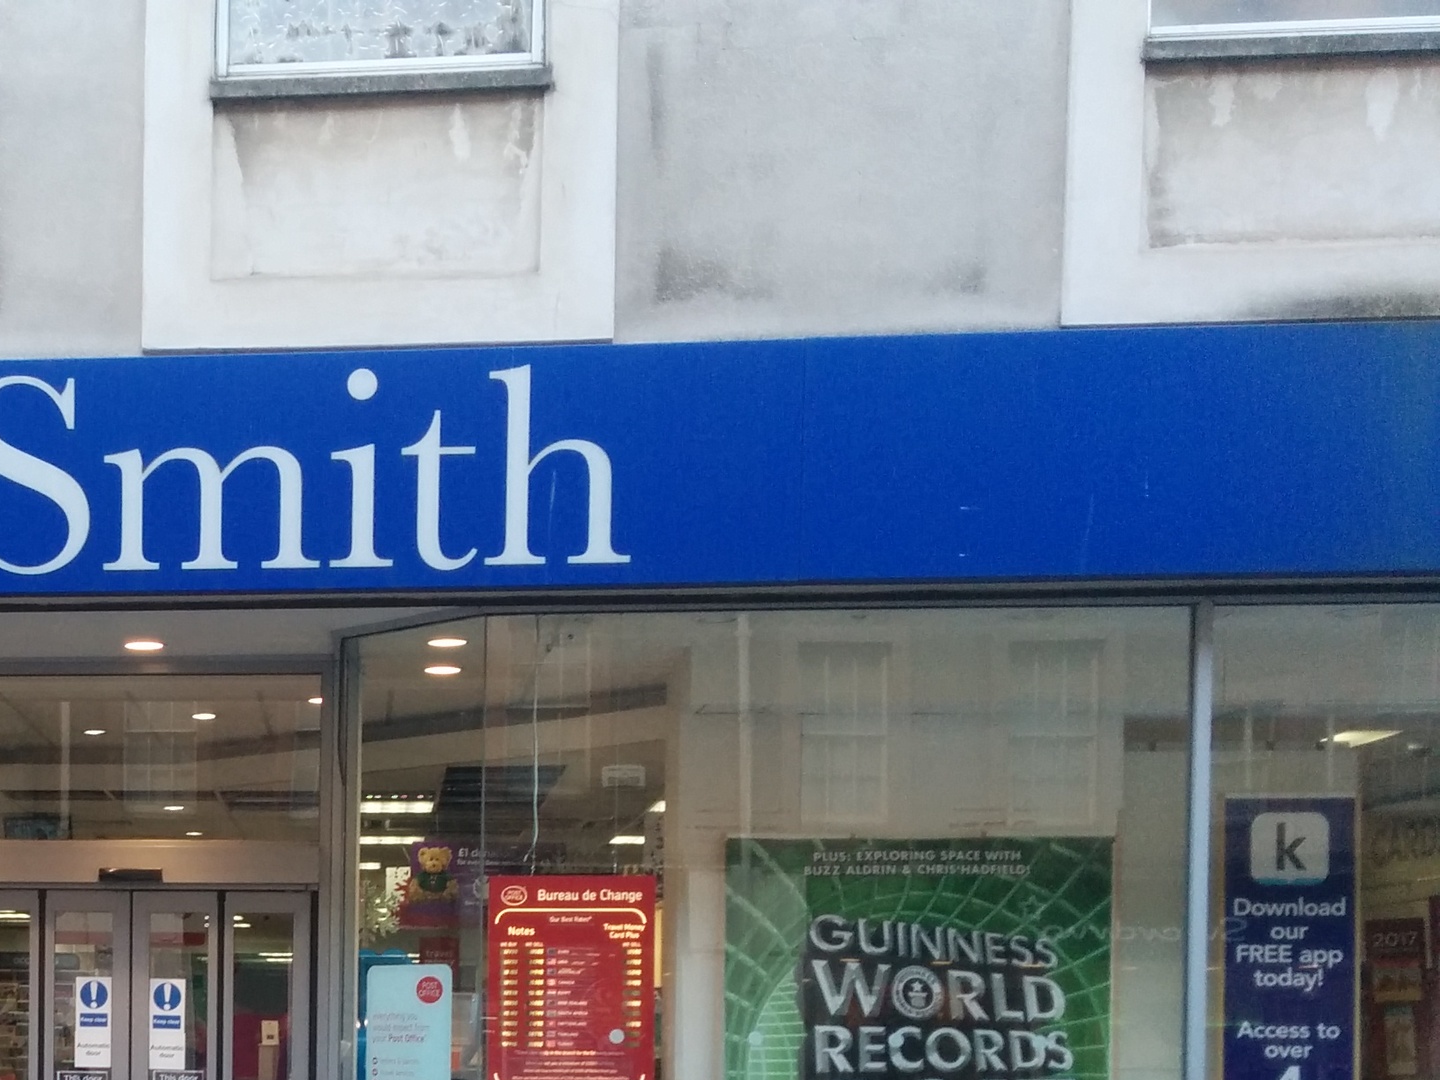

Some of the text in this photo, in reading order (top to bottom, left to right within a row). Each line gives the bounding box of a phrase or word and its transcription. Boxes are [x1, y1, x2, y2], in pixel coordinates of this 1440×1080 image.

[1276, 822, 1307, 872] k
[813, 850, 1022, 863] PLUS: EXPLORING SPACE WITH
[804, 865, 841, 875] BUZZ
[846, 865, 896, 875] ALDRIN
[902, 865, 911, 875] &
[917, 864, 959, 875] CHRIS
[537, 889, 643, 903] Bureau de Change
[1233, 897, 1347, 917] Download
[507, 926, 536, 937] Notes
[1270, 923, 1309, 941] our
[808, 914, 1059, 969] GUINNESS
[1235, 945, 1344, 968] FREE app
[422, 981, 438, 989] POST
[1253, 968, 1324, 992] today!
[418, 989, 441, 997] OFFICE
[811, 959, 1067, 1023] WORLD
[1236, 1021, 1341, 1040] Access to
[813, 1024, 1075, 1074] RECORDS
[1264, 1043, 1314, 1060] over
